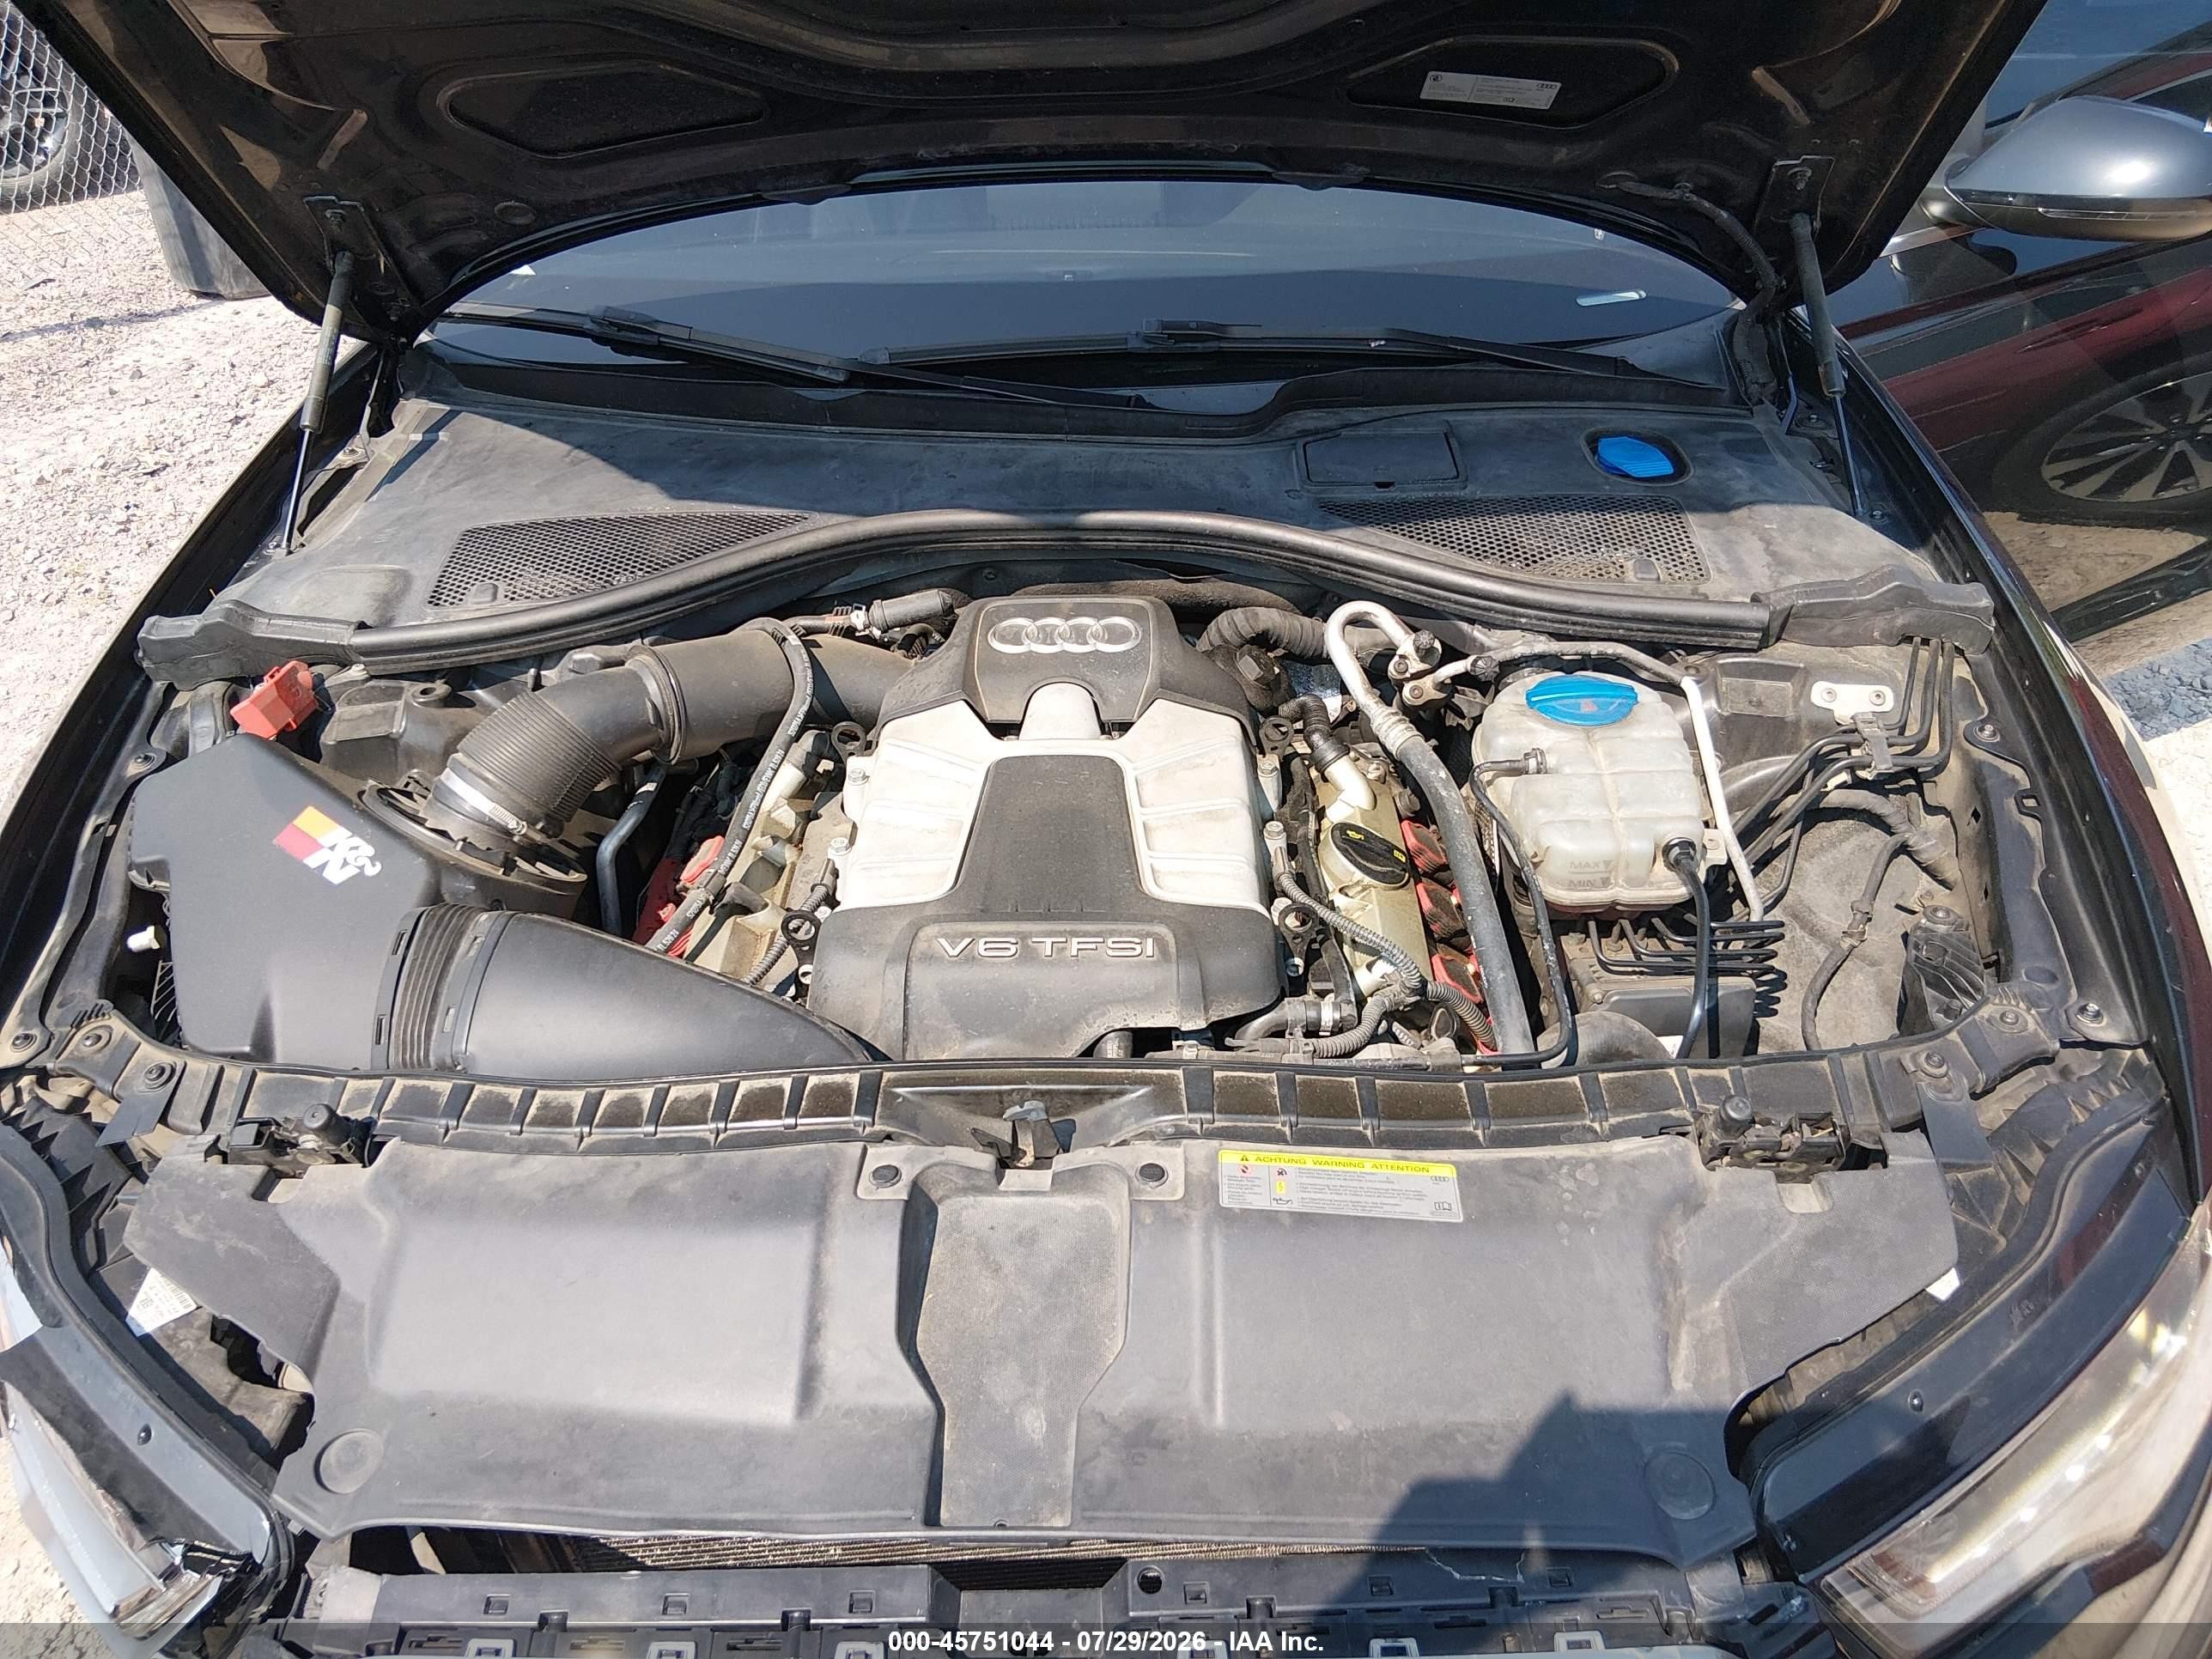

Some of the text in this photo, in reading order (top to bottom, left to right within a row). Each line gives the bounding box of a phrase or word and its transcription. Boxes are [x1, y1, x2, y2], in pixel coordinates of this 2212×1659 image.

[303, 826, 382, 884] K&N
[1570, 860, 1601, 869] MAX
[1568, 879, 1595, 888] MIN
[935, 937, 1155, 958] V6 TFSI
[1255, 1156, 1430, 1173] ACHTUNG WARNING ATTENTION
